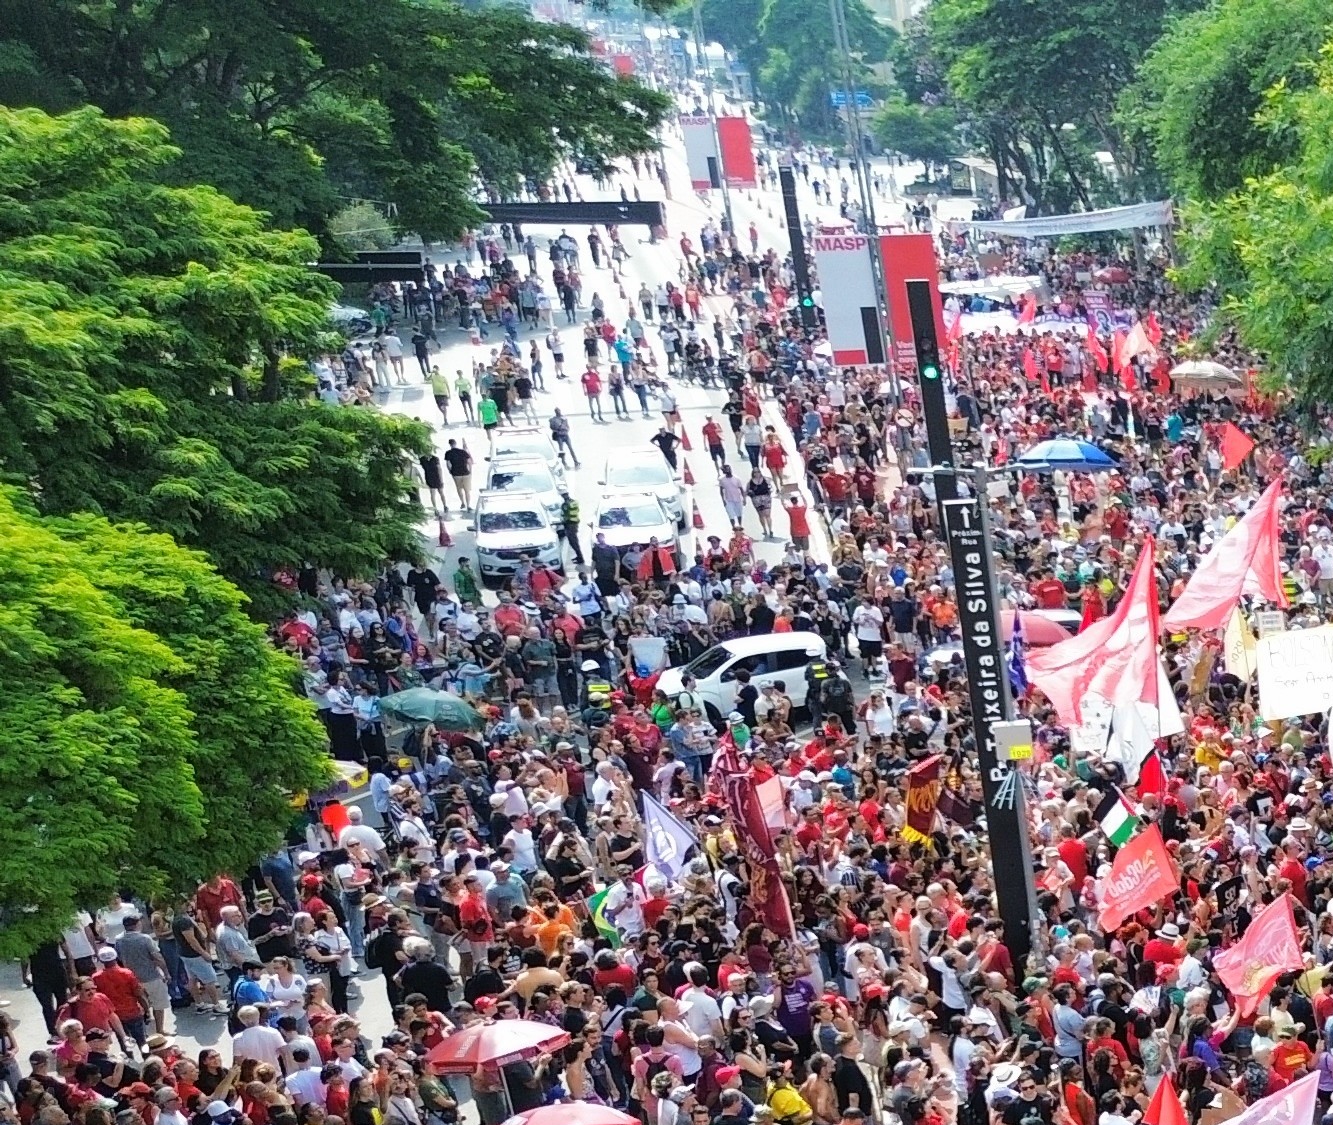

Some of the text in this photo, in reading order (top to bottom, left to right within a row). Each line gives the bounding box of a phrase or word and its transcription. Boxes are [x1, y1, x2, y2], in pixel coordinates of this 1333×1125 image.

[681, 117, 710, 126] MASP
[815, 237, 866, 251] MASP
[964, 551, 988, 613] Silva
[971, 620, 992, 649] da
